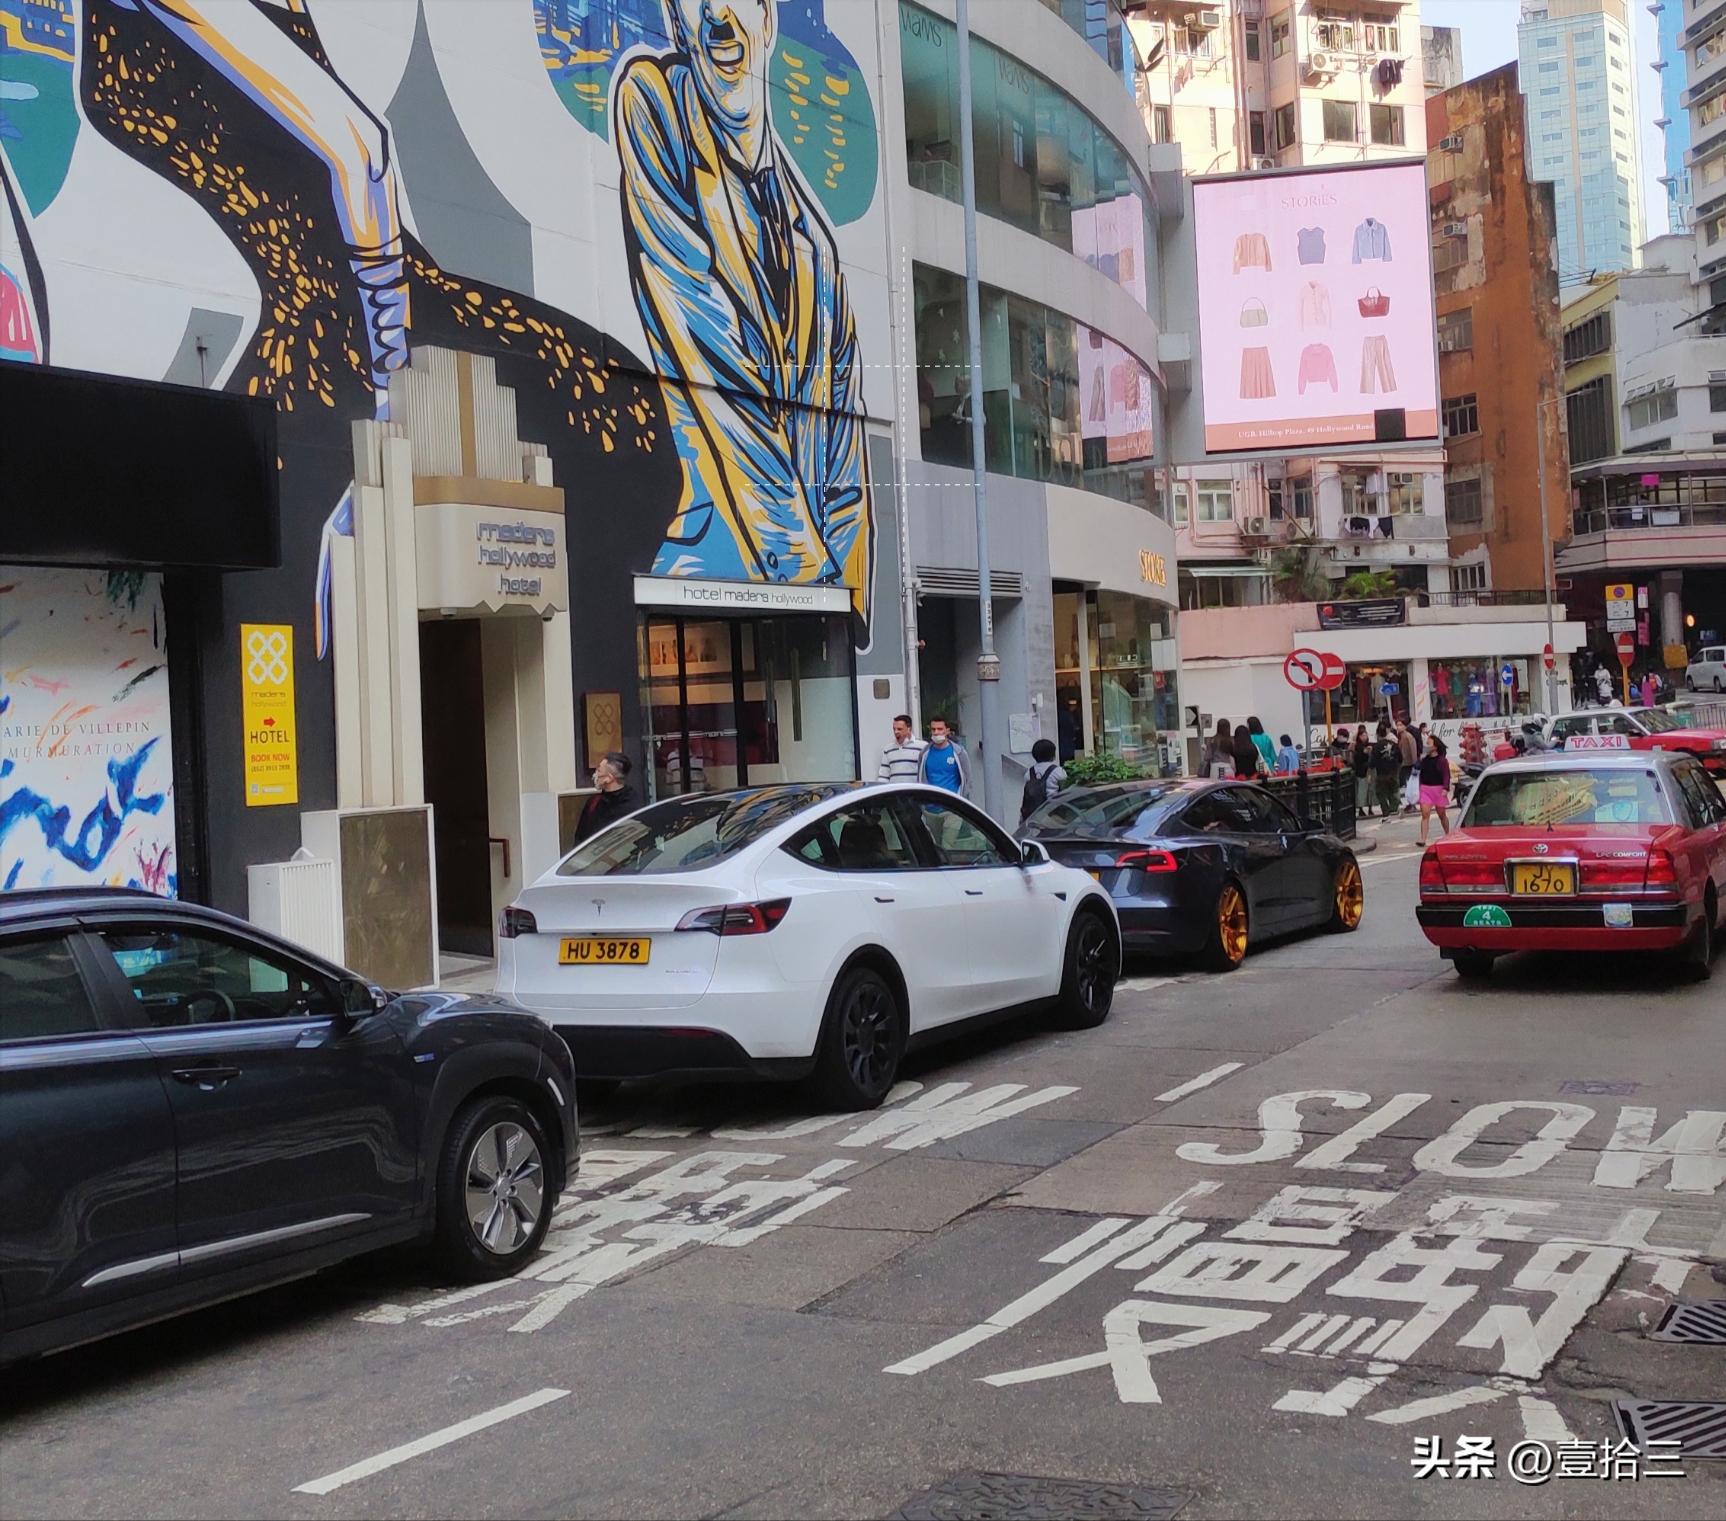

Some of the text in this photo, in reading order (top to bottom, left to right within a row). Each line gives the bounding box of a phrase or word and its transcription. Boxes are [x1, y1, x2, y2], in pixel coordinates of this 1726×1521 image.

[478, 545, 556, 570] hollywood
[498, 573, 542, 596] hotel
[683, 585, 813, 607] hotel madera hollywood
[51, 723, 70, 736] DE
[79, 721, 151, 735] VILLEPIN
[250, 730, 290, 744] HOTEL
[1570, 736, 1623, 748] TAXI
[251, 753, 290, 763] BOOK NOW
[1532, 865, 1553, 880] JY
[1523, 879, 1565, 893] 1670
[1482, 911, 1491, 920] 4
[567, 942, 640, 960] HU 3878
[1176, 1090, 1726, 1194] SLOW
